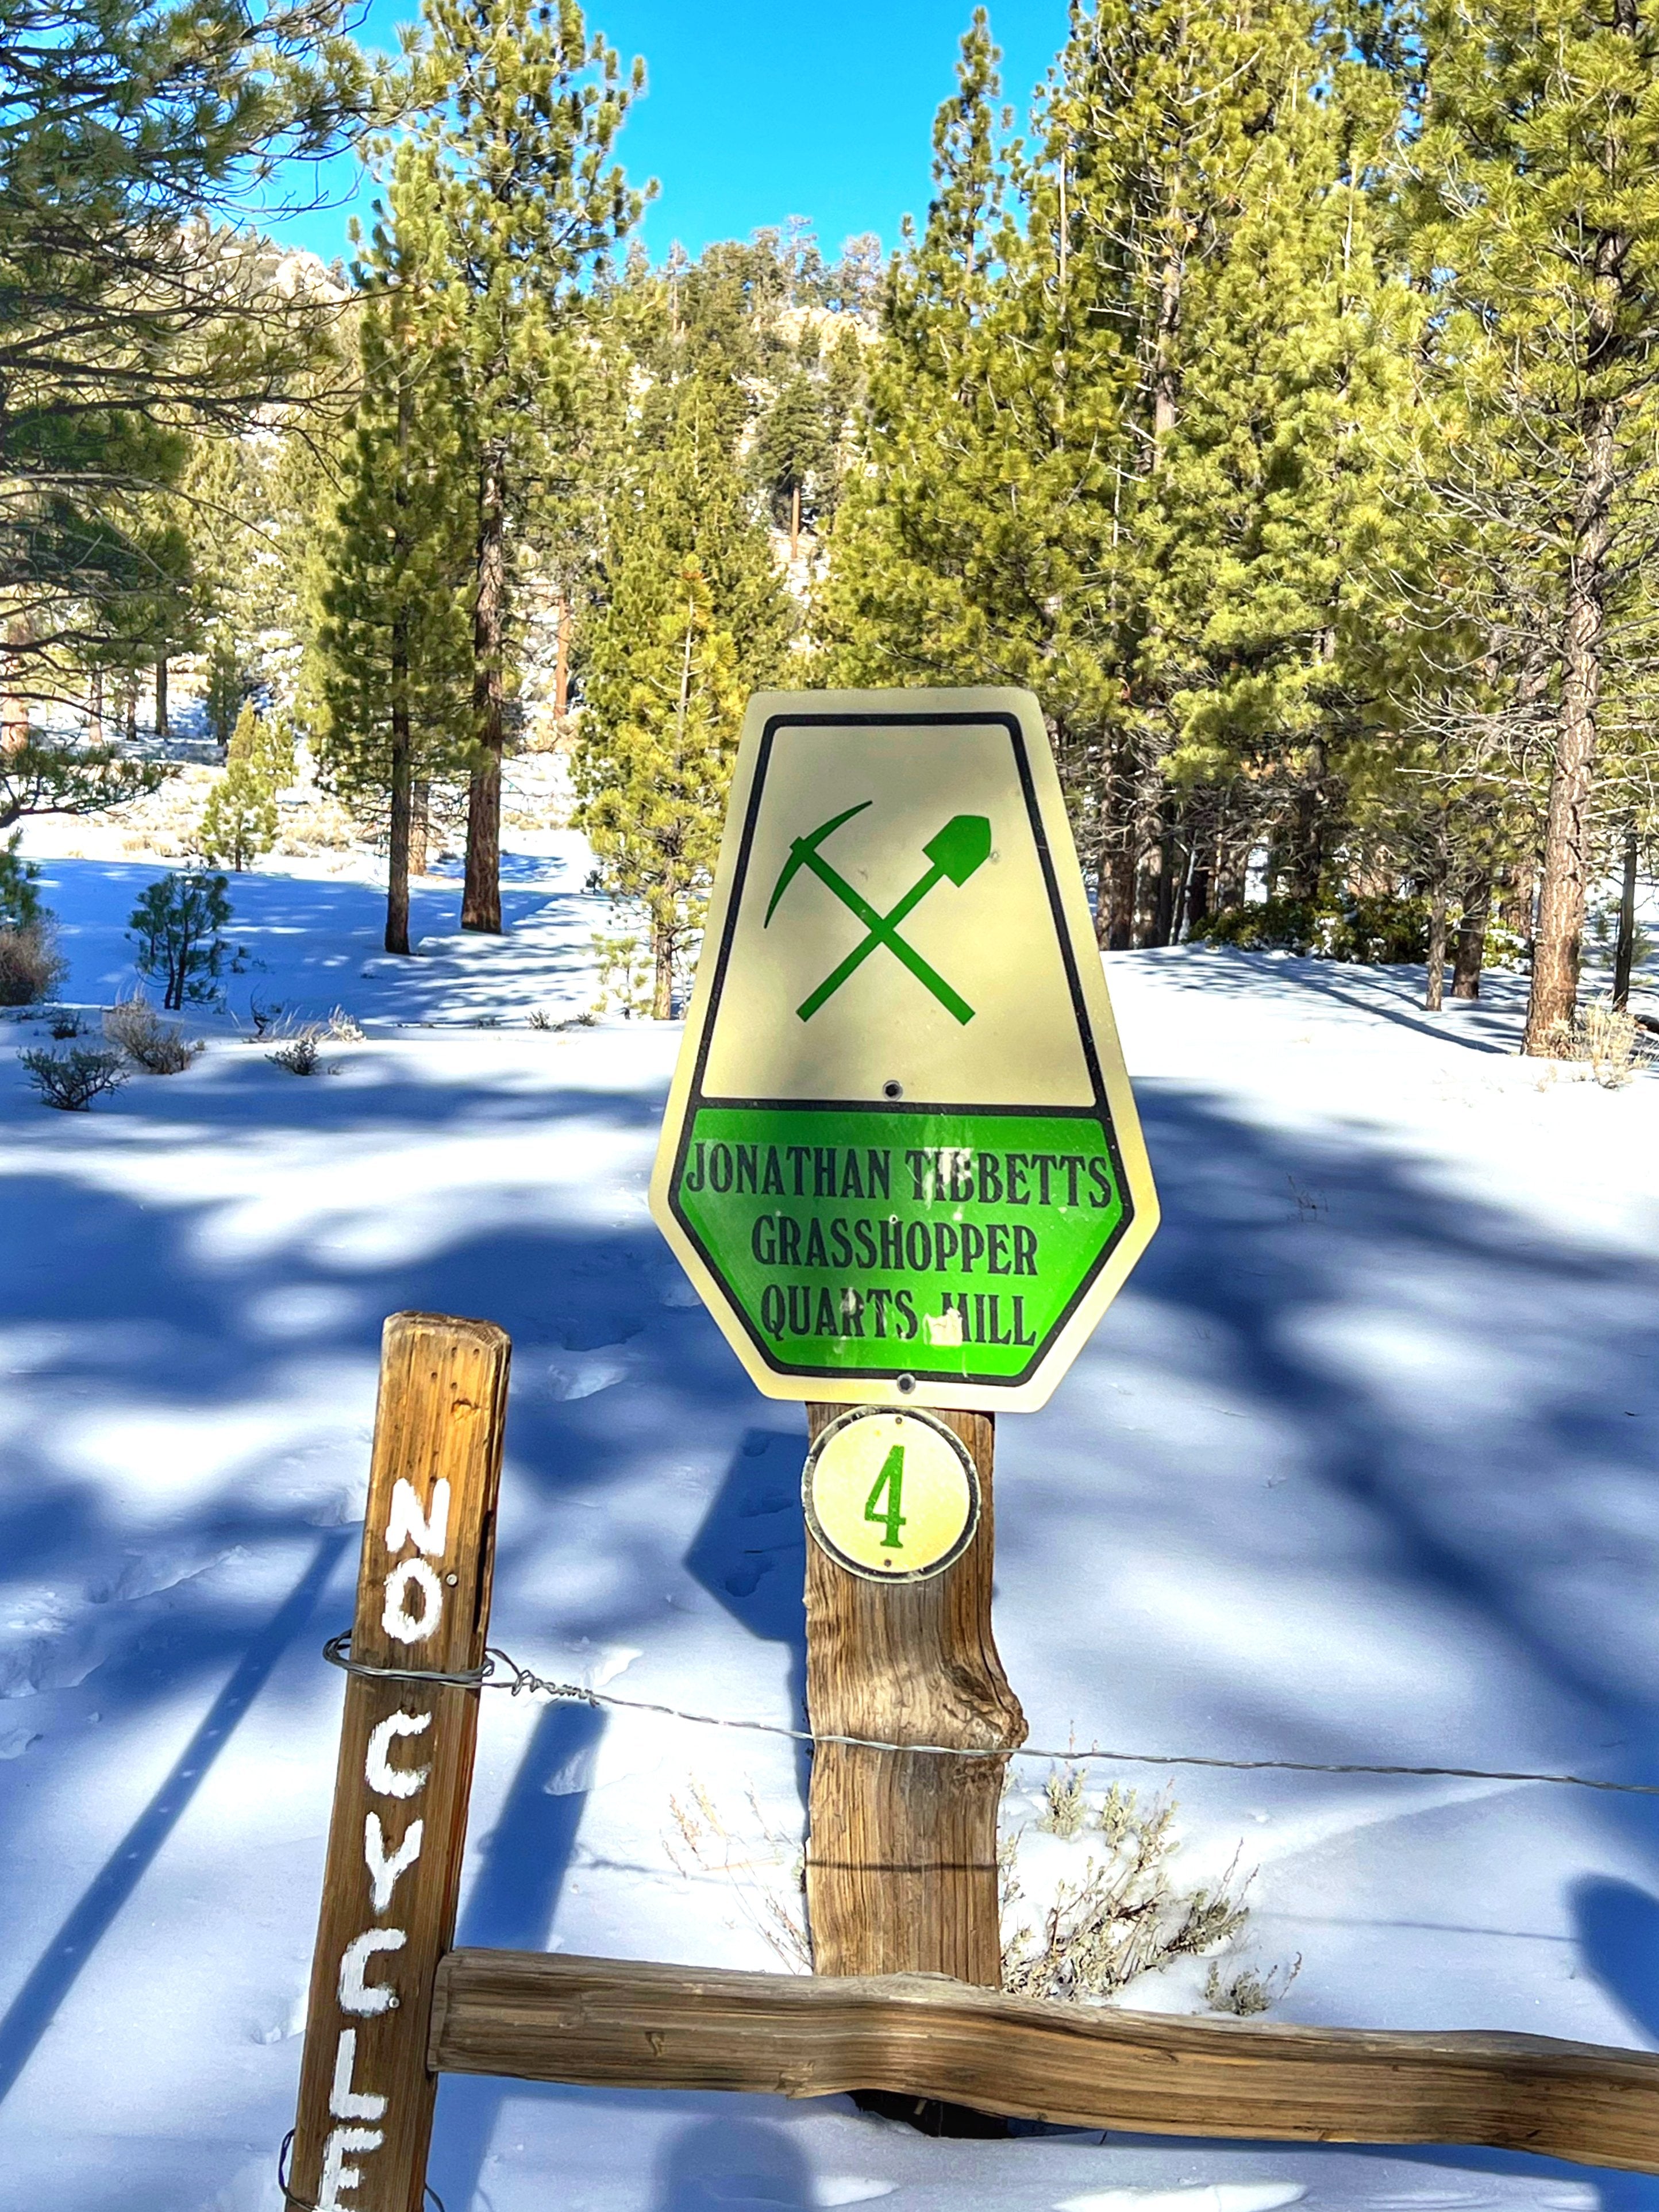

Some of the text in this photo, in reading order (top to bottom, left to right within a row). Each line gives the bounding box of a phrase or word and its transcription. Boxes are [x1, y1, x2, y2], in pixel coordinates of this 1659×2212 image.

[686, 1142, 1111, 1208] JONATHAN TIBBETTS
[751, 1214, 1038, 1276] GRASSHOPPER
[761, 1284, 918, 1341] QUARTS
[864, 1444, 907, 1549] 4
[382, 1478, 451, 1644] NO
